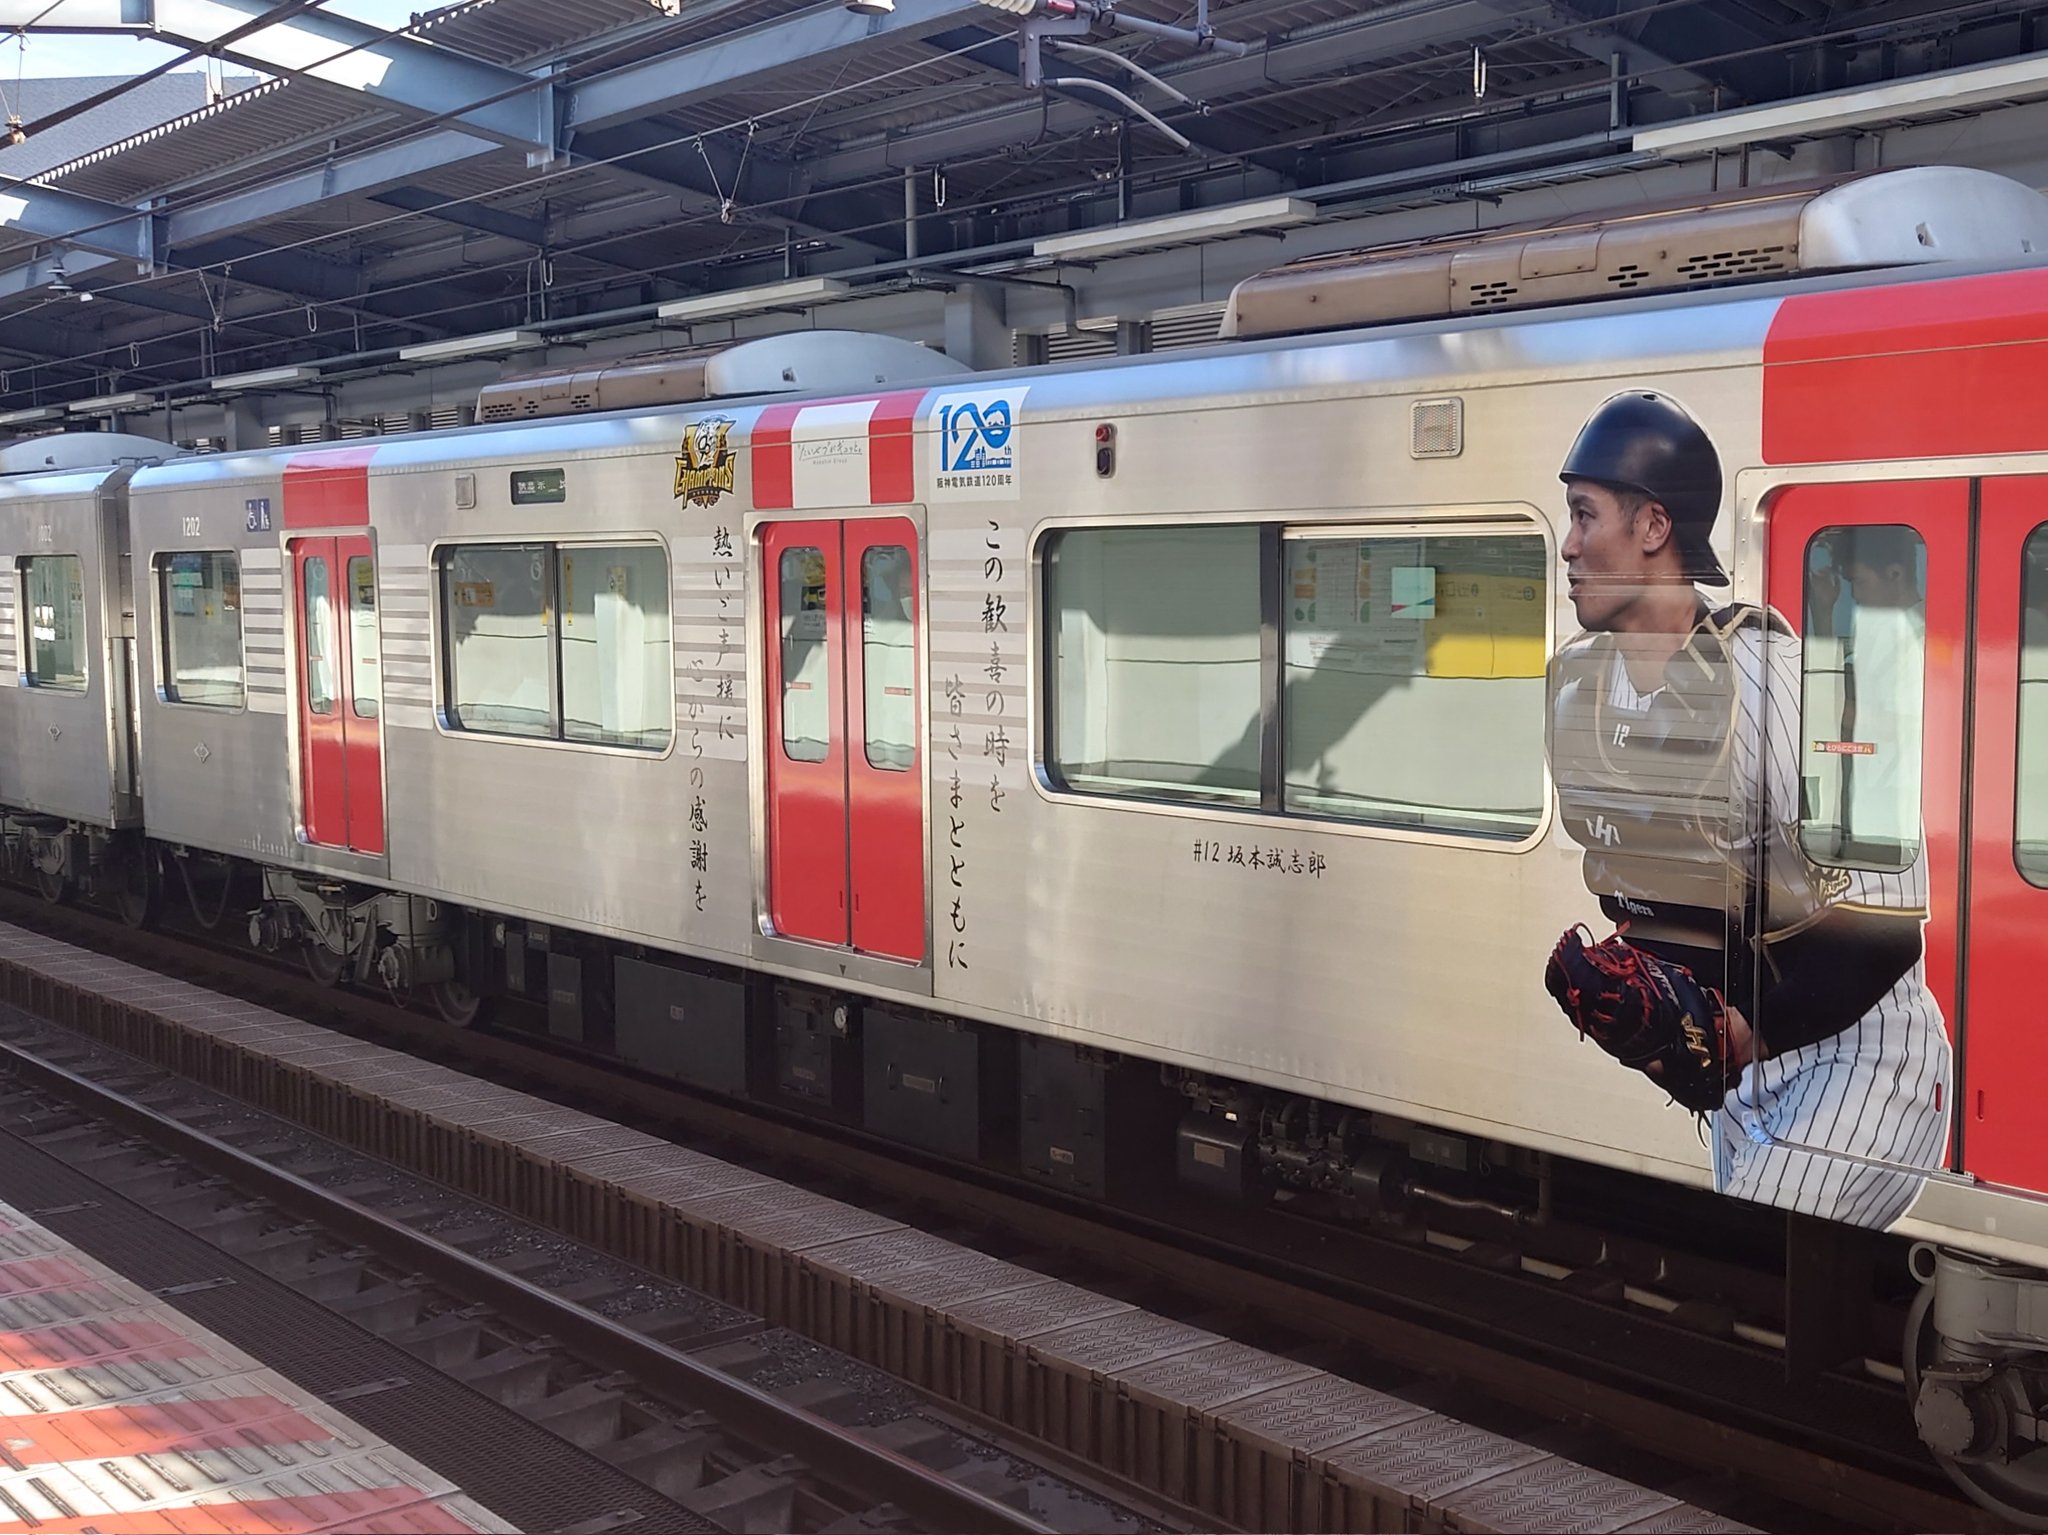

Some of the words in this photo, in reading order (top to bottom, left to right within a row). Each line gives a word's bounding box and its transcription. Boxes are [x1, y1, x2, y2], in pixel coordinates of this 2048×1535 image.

[936, 474, 1012, 488] 阪神電気鉄道120周年
[182, 516, 201, 536] 1202
[981, 519, 1010, 812] この歓喜の時を
[1613, 723, 1631, 749] 12
[945, 673, 968, 969] 皆さまとともに
[1193, 839, 1220, 863] #12
[1227, 845, 1326, 879] 坂本誠志郎
[1614, 890, 1655, 917] Tigers
